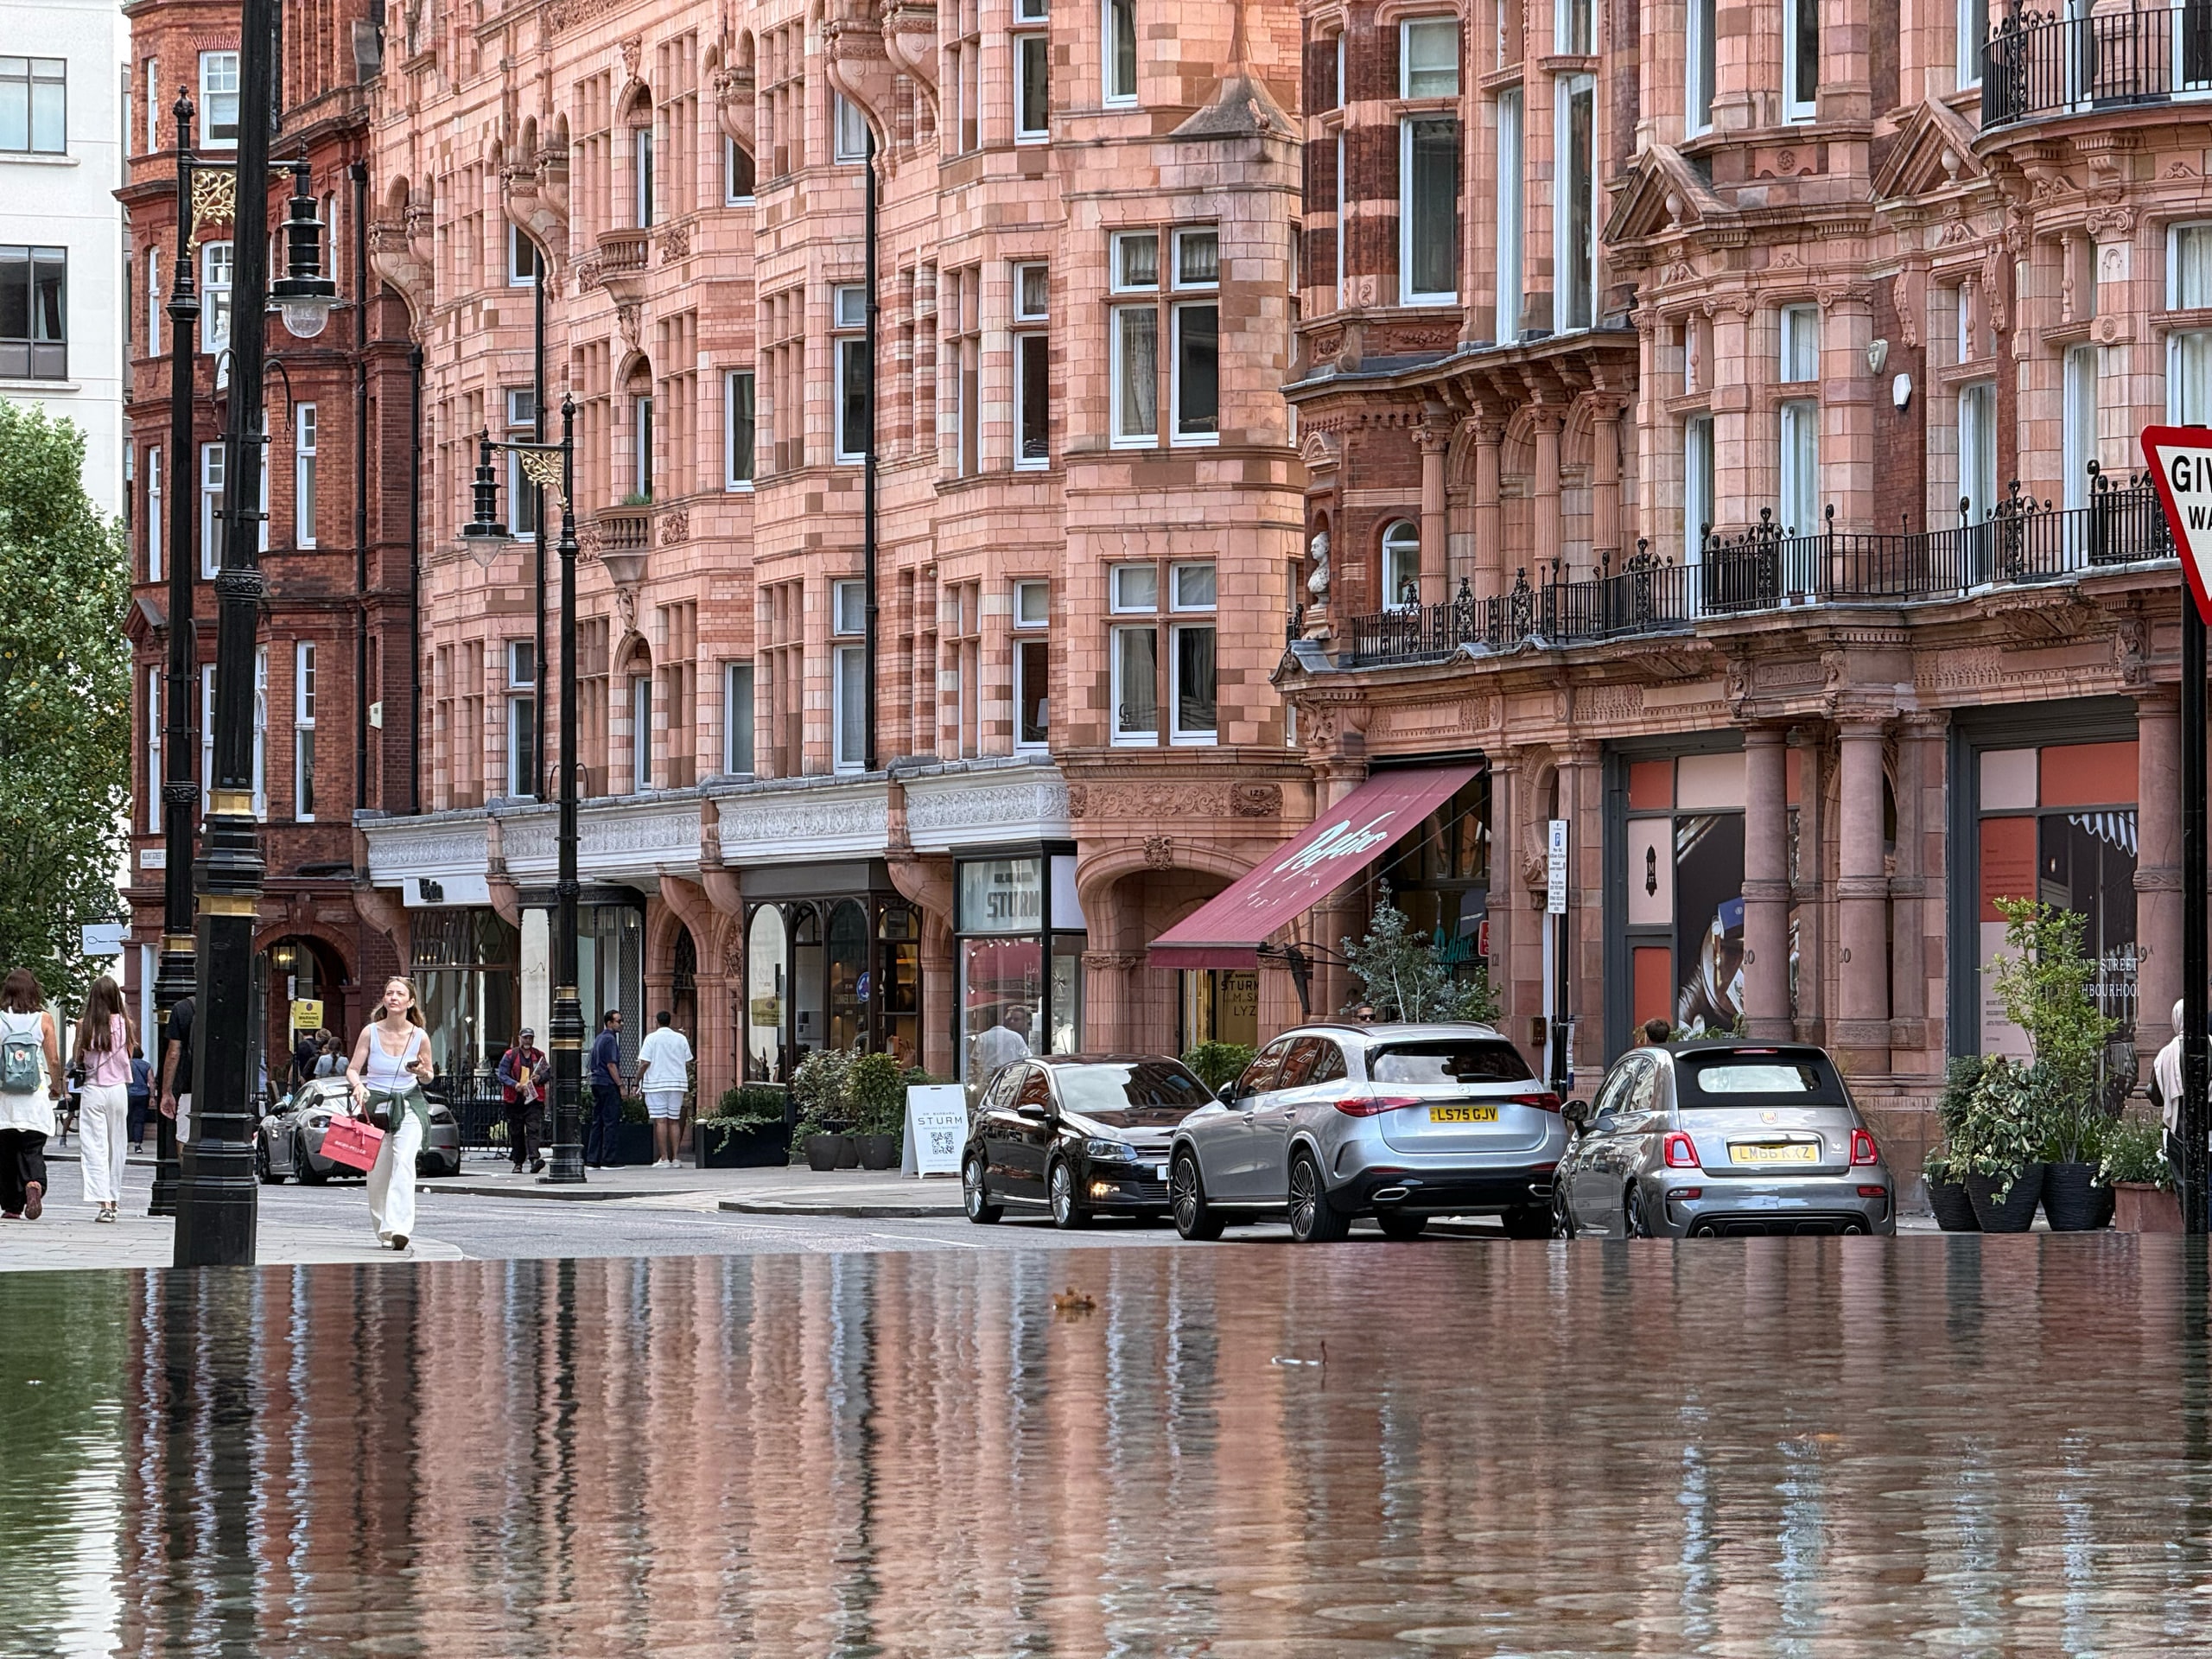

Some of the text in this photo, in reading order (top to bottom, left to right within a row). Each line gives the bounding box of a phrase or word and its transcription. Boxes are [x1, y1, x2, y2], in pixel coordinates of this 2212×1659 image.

[987, 890, 1039, 918] STURM
[2100, 957, 2138, 971] STREET
[918, 1116, 963, 1126] STURM
[1437, 1108, 1496, 1121] LS75 GJV
[1739, 1146, 1811, 1160] LM66 KXZ
